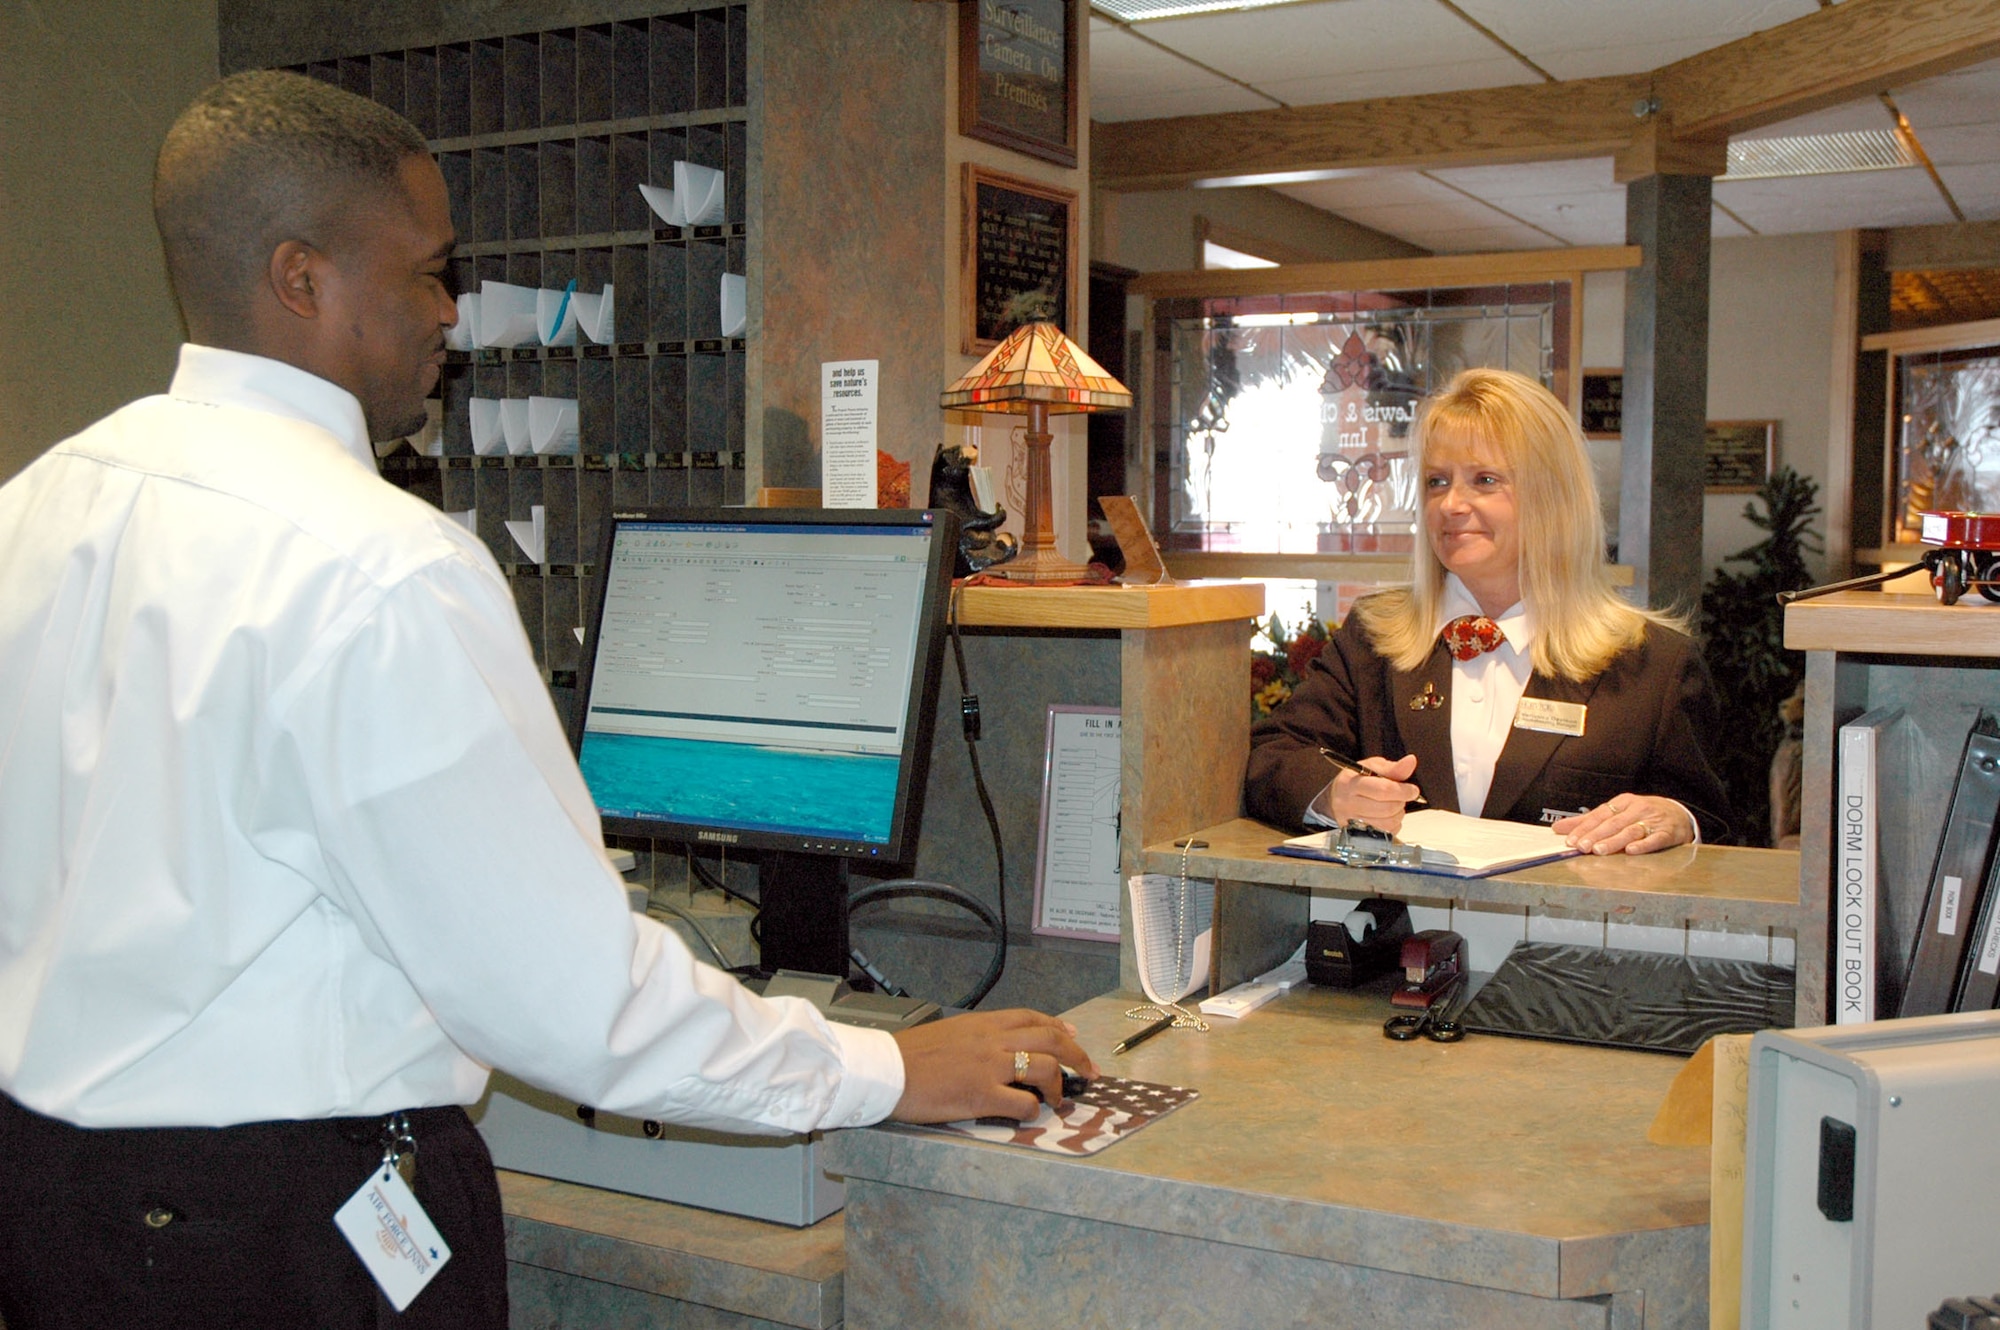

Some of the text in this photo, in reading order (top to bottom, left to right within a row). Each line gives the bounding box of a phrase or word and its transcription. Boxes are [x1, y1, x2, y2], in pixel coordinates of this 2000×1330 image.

[985, 0, 1059, 48] Surveillance
[985, 33, 1058, 82] Camera On
[995, 72, 1047, 112] Premises
[832, 368, 865, 377] and help us
[844, 377, 867, 387] nature's
[833, 389, 863, 398] resources.
[1085, 719, 1099, 728] FILL
[1105, 720, 1112, 728] IN
[698, 830, 738, 843] SAMSUNG
[1845, 795, 1863, 1012] DORM LOCK OUT BOOK
[367, 1191, 426, 1275] AIR FORCE INNS
